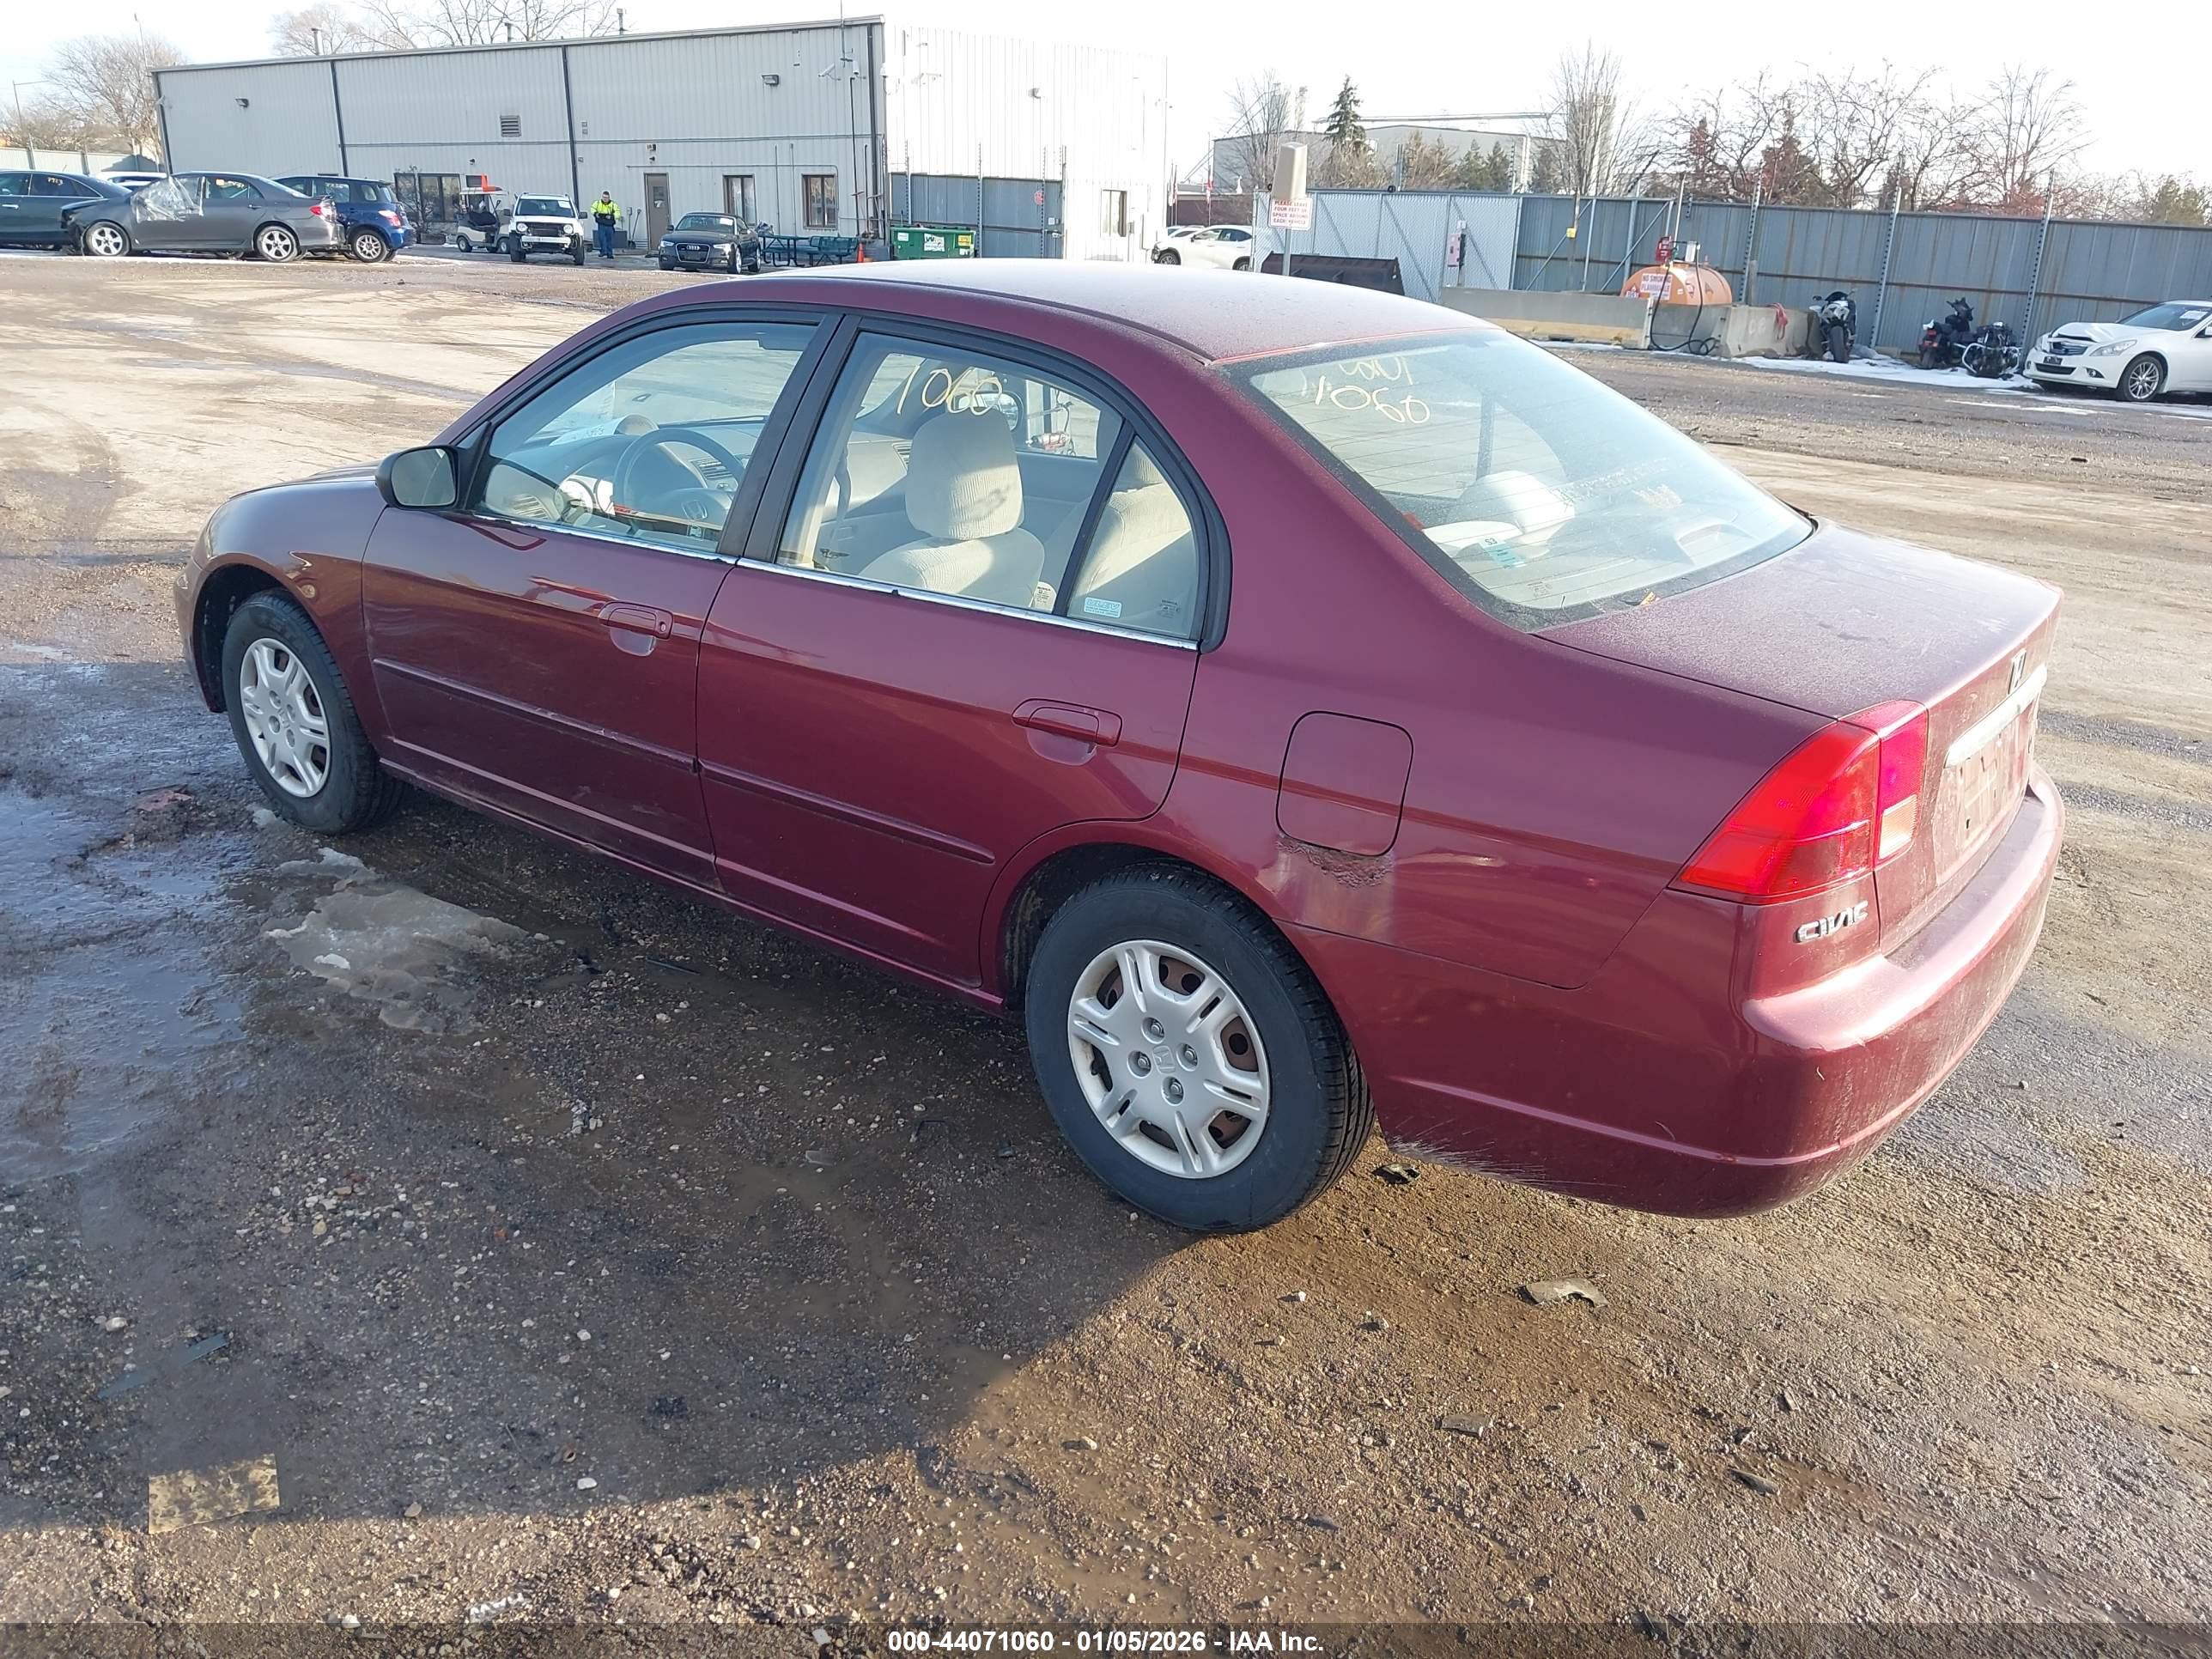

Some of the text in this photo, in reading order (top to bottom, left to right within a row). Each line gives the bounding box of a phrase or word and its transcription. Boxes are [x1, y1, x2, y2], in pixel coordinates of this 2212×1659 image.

[896, 364, 1003, 416] 1060
[1315, 374, 1431, 424] 1060
[1796, 900, 1869, 943] CIVIC
